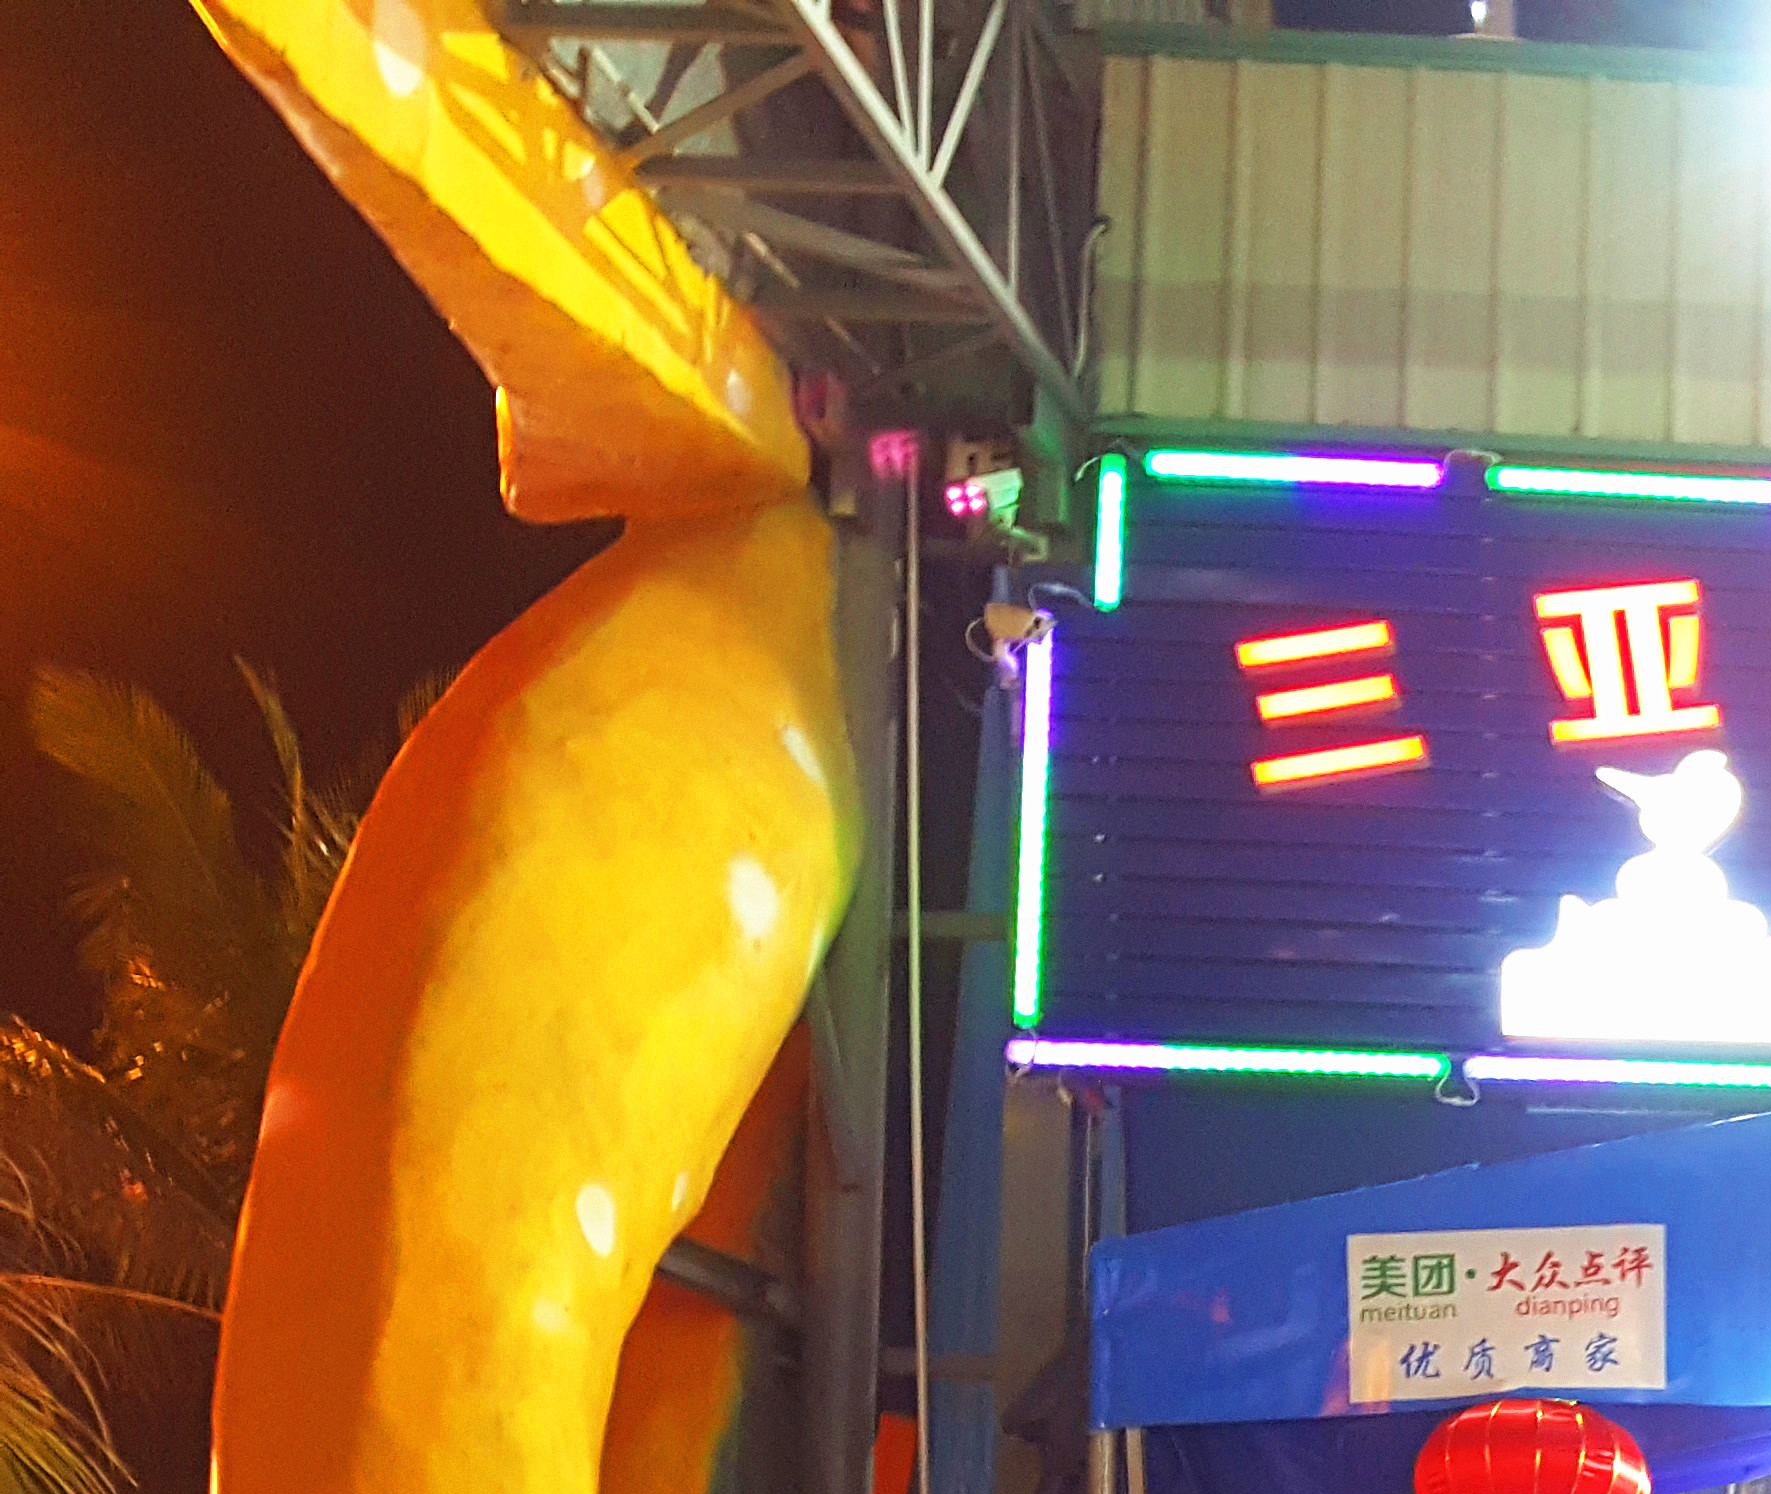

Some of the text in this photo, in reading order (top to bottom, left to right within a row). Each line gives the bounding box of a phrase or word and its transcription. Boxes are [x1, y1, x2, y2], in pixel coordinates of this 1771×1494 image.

[1360, 1293, 1621, 1323] meituan dianping
[1400, 1333, 1621, 1381] 优质商家
